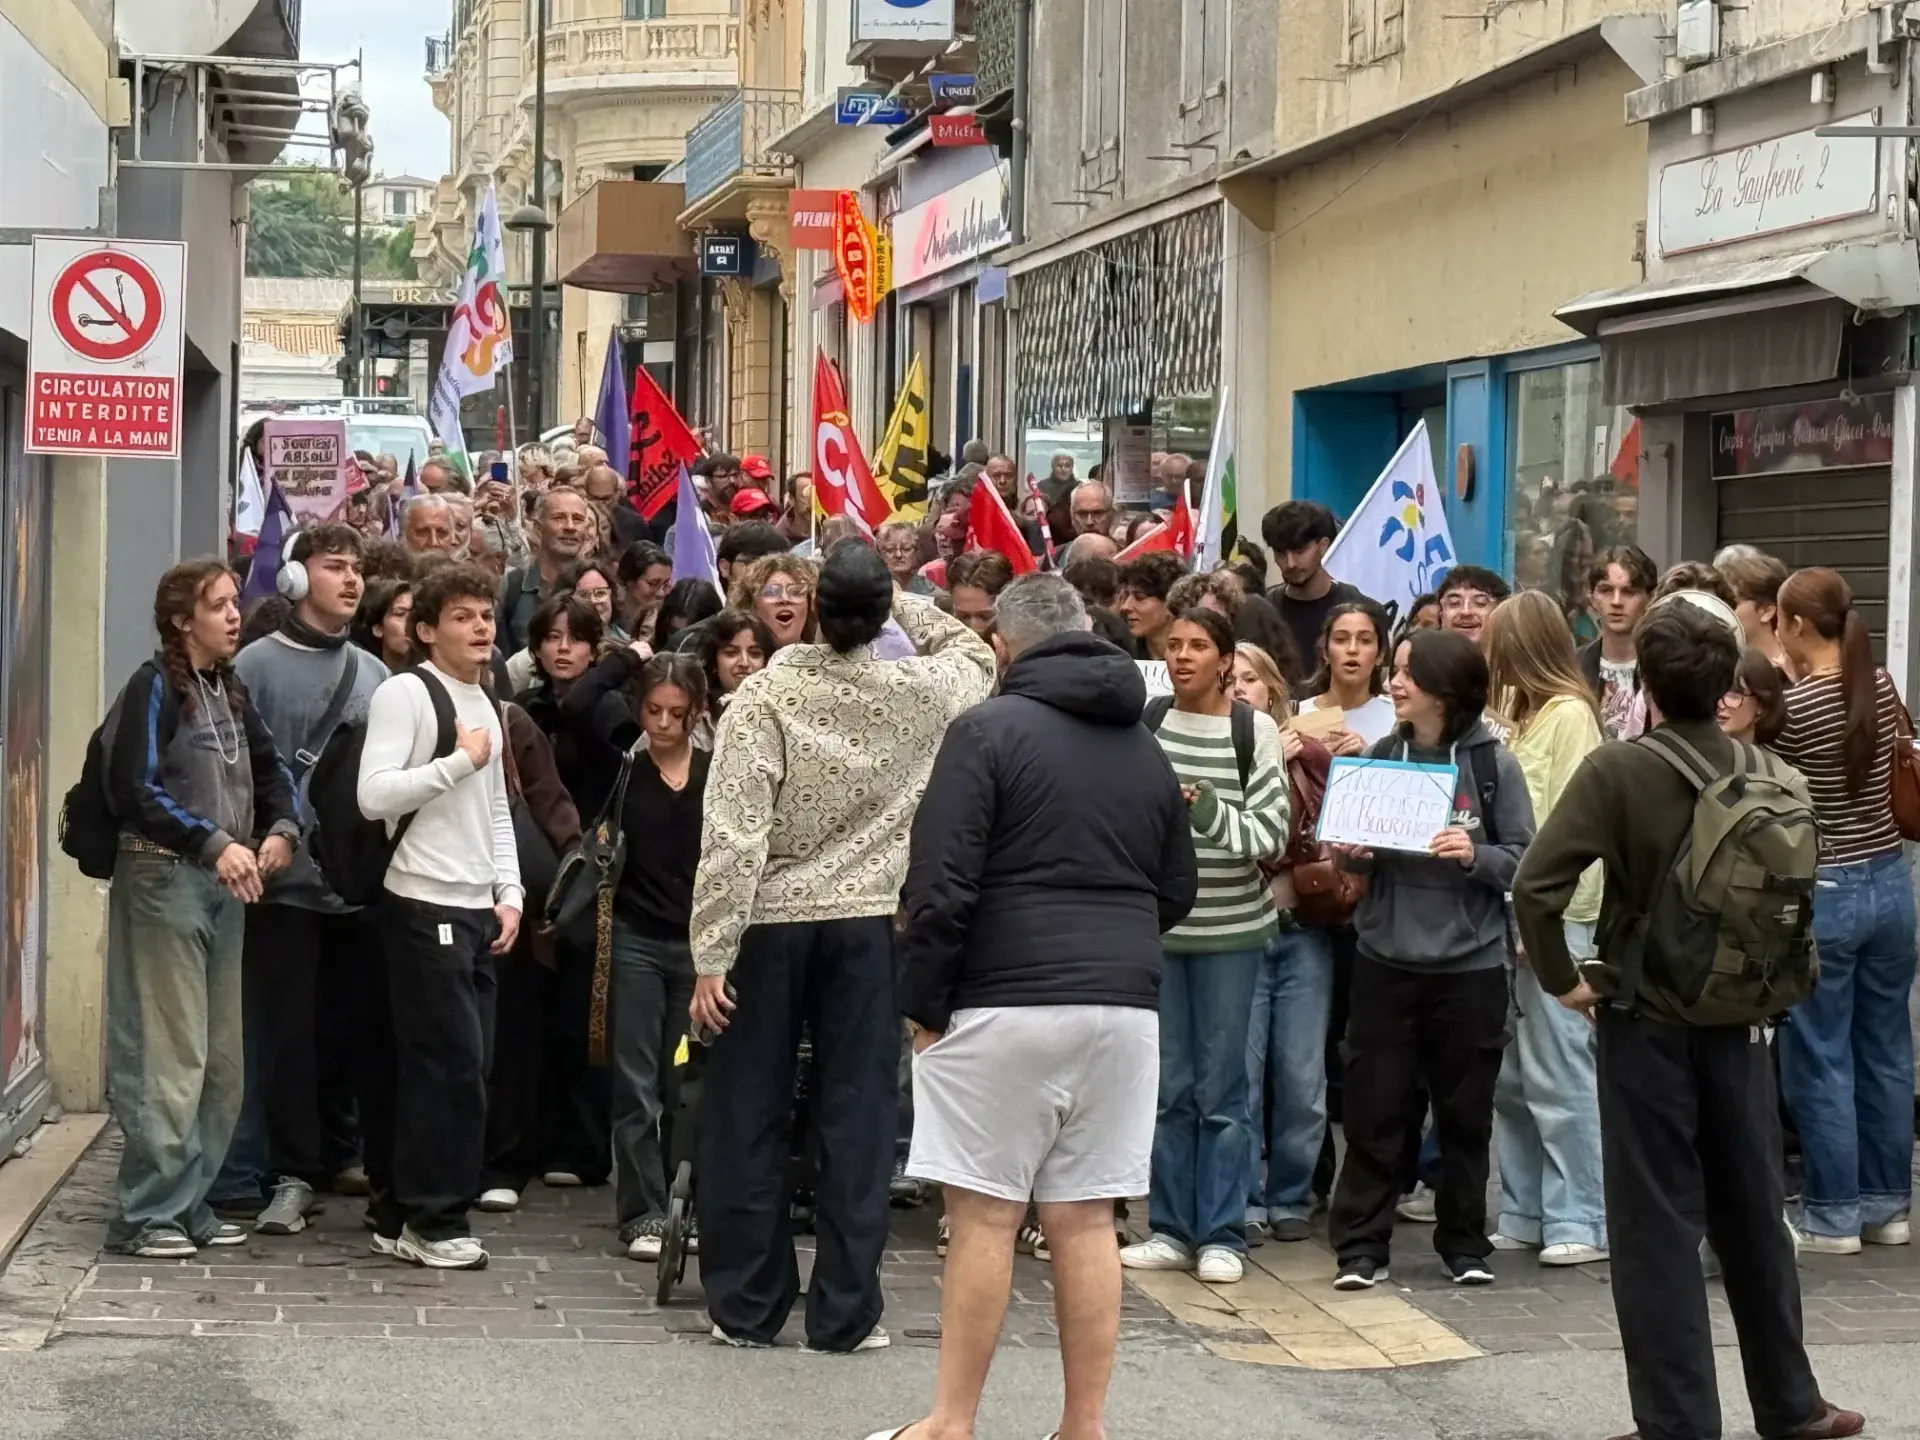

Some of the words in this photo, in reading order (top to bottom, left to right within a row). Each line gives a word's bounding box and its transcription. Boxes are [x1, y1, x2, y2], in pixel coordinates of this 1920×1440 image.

[1694, 157, 1724, 217] La
[1733, 141, 1806, 222] Gaufrerie
[1814, 143, 1831, 189] 2
[40, 378, 170, 400] CIRCULATION
[39, 400, 169, 423] INTERDITE
[37, 427, 82, 443] TENIR
[87, 426, 98, 444] À
[104, 429, 123, 445] LA
[129, 431, 168, 446] MAIN
